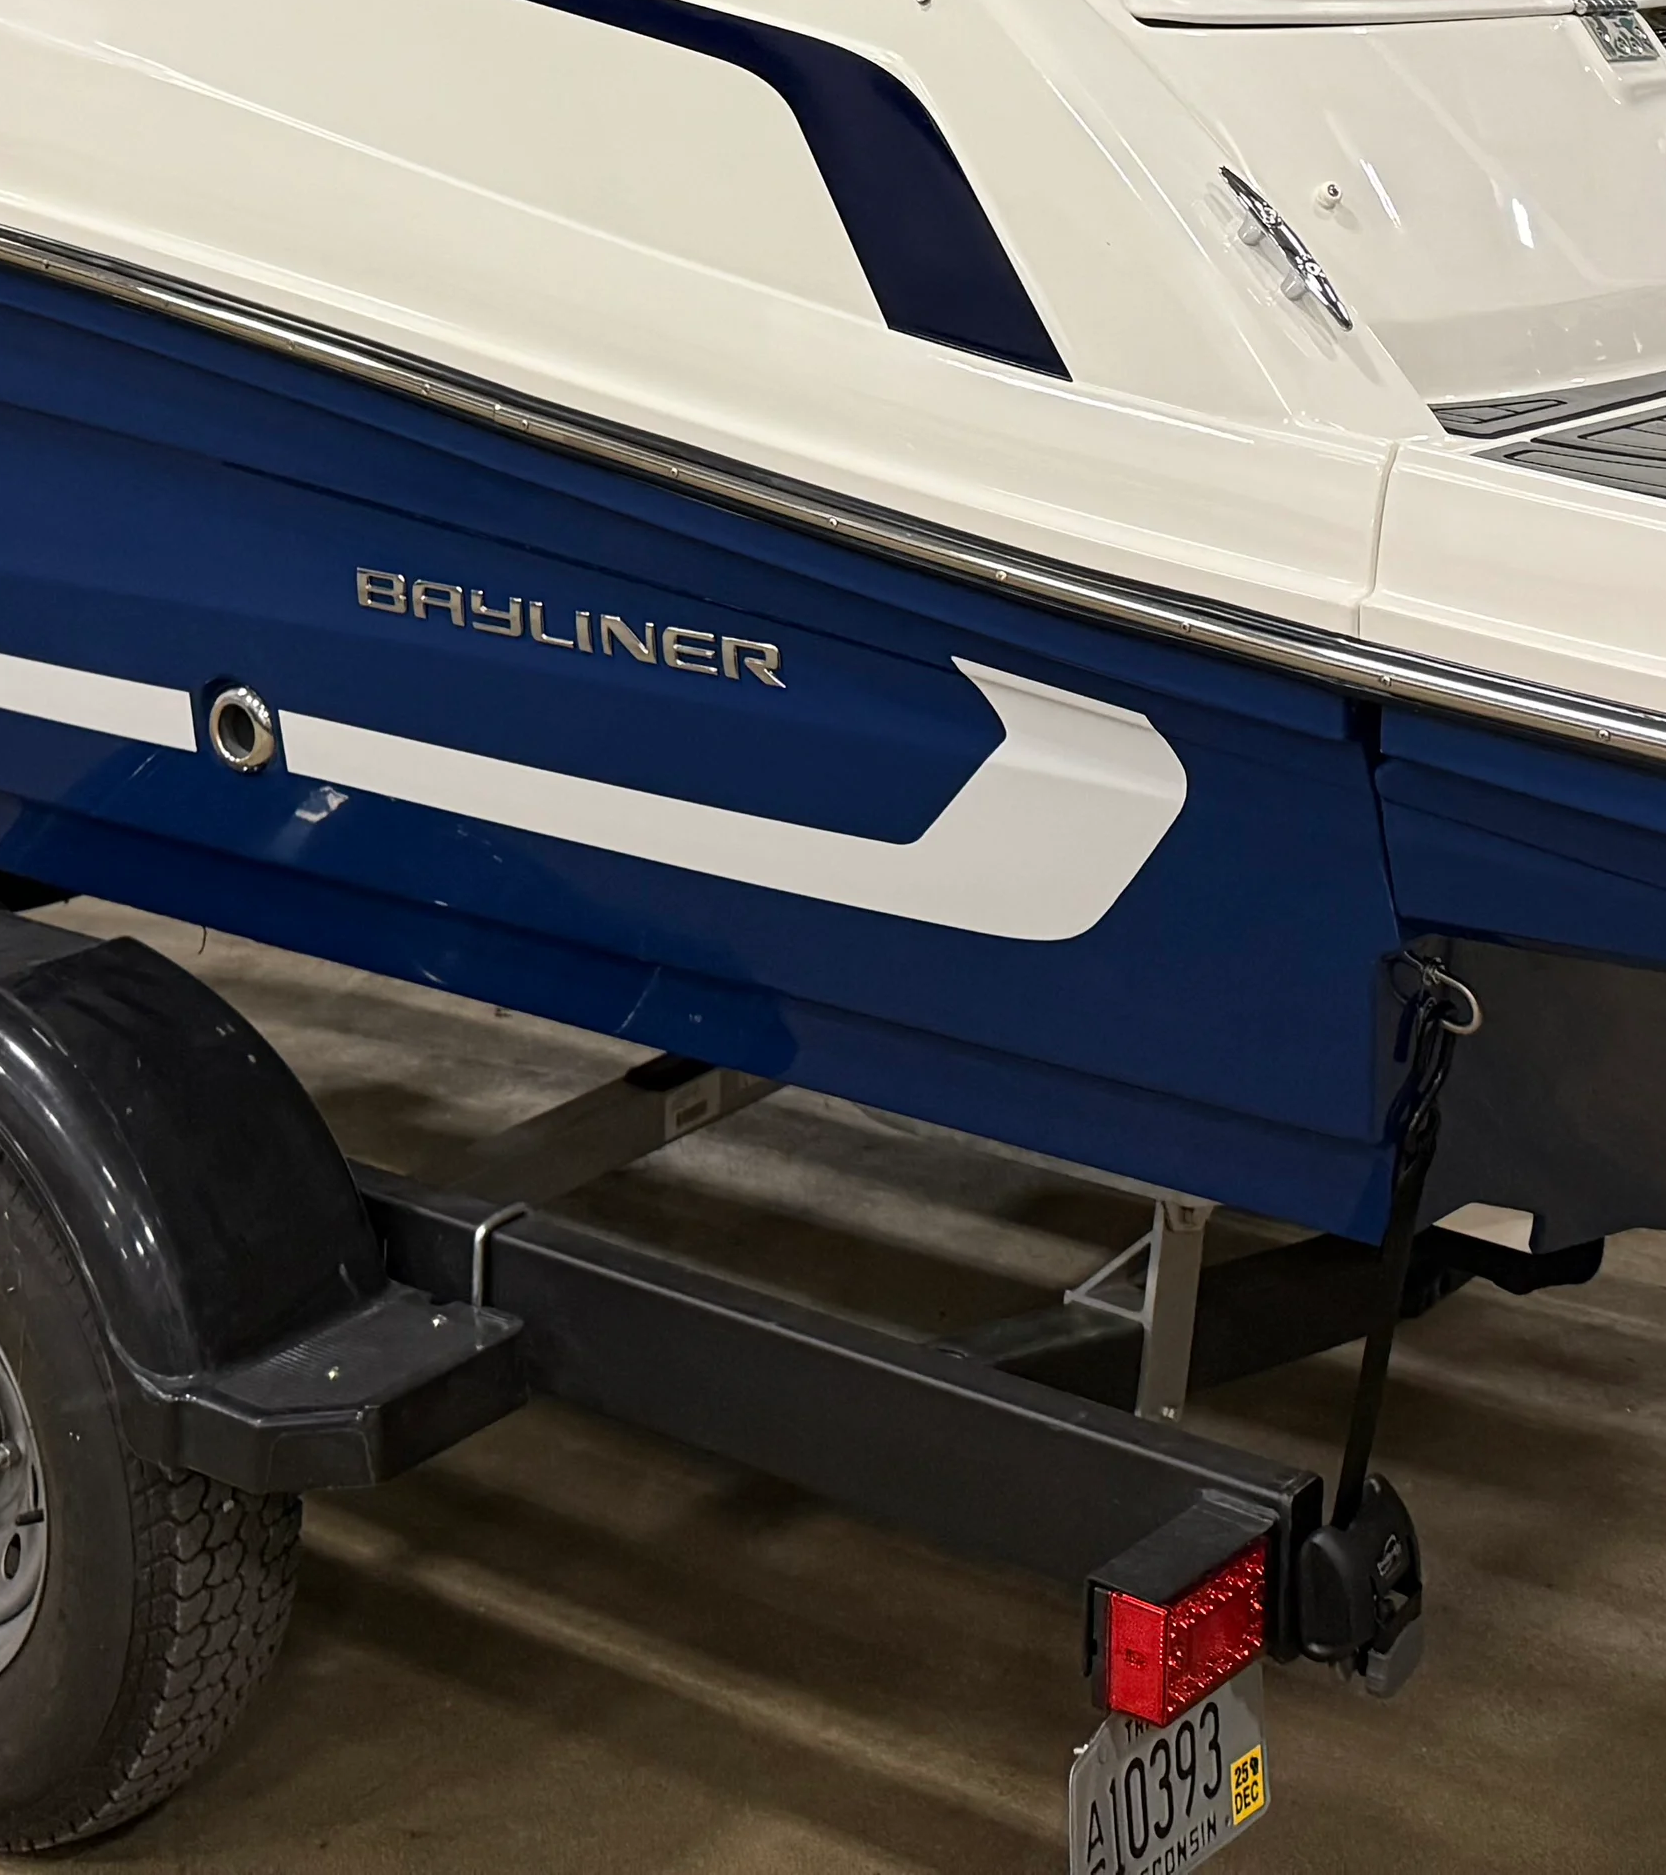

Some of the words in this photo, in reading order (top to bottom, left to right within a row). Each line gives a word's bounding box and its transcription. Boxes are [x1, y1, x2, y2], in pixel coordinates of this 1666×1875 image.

[355, 566, 788, 689] BAYLINER
[1234, 1761, 1249, 1789] 25
[1234, 1780, 1260, 1816] DEC
